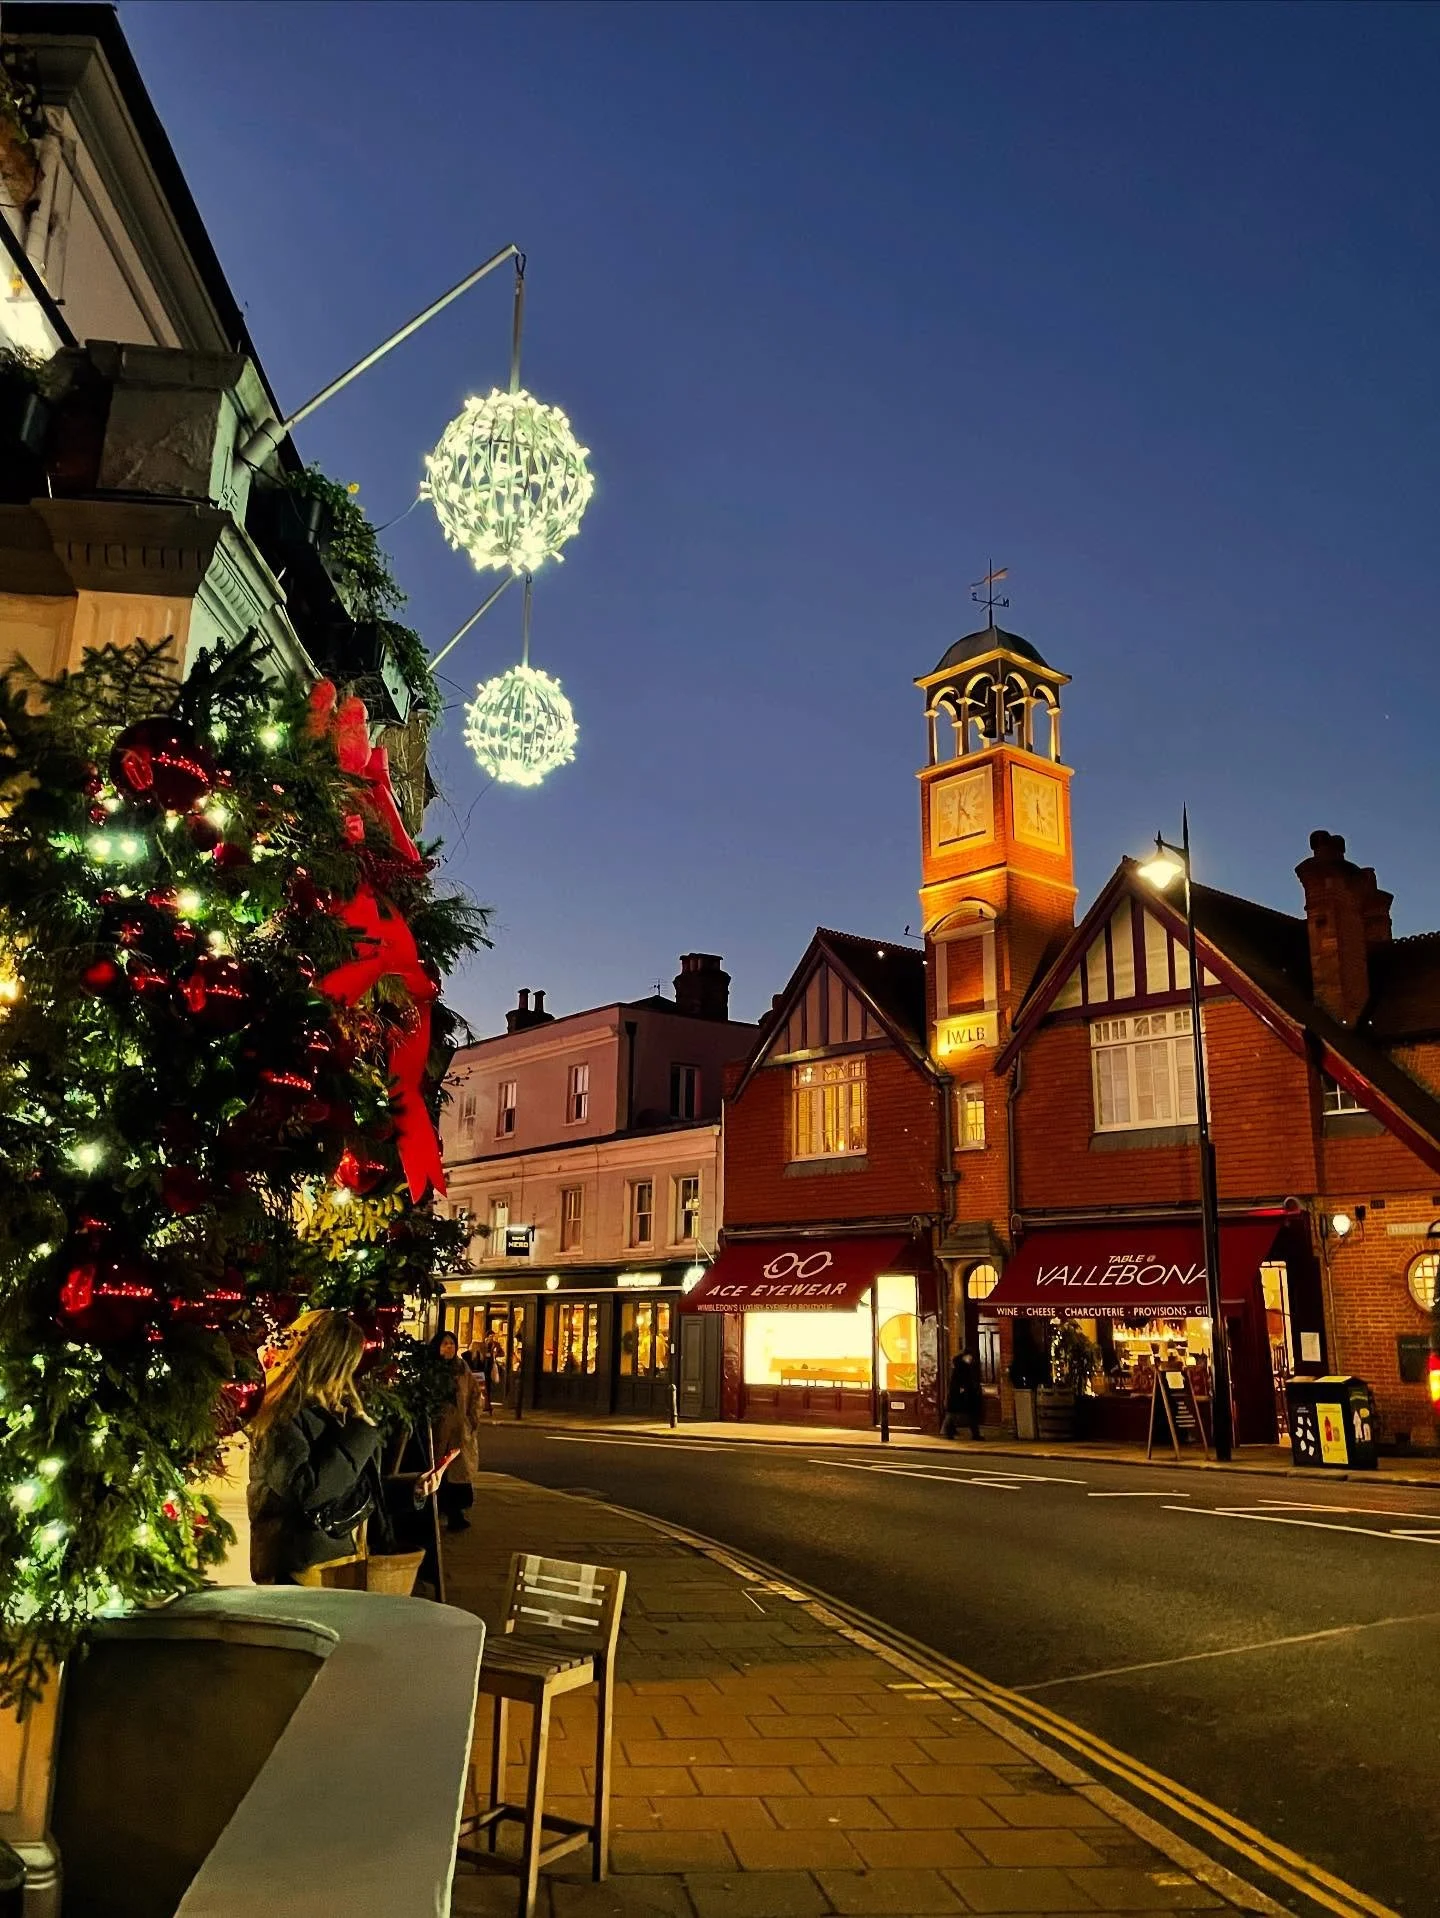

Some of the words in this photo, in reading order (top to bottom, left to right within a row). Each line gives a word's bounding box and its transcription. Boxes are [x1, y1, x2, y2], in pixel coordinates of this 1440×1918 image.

[1108, 1254, 1145, 1263] TABLE
[706, 1285, 748, 1297] ACE
[750, 1282, 848, 1297] EYEWEAR
[997, 1307, 1018, 1316] WINE
[1026, 1307, 1056, 1317] CHEESE
[1065, 1307, 1125, 1317] CHARCUTERIE
[1133, 1306, 1187, 1316] PROVISIONS
